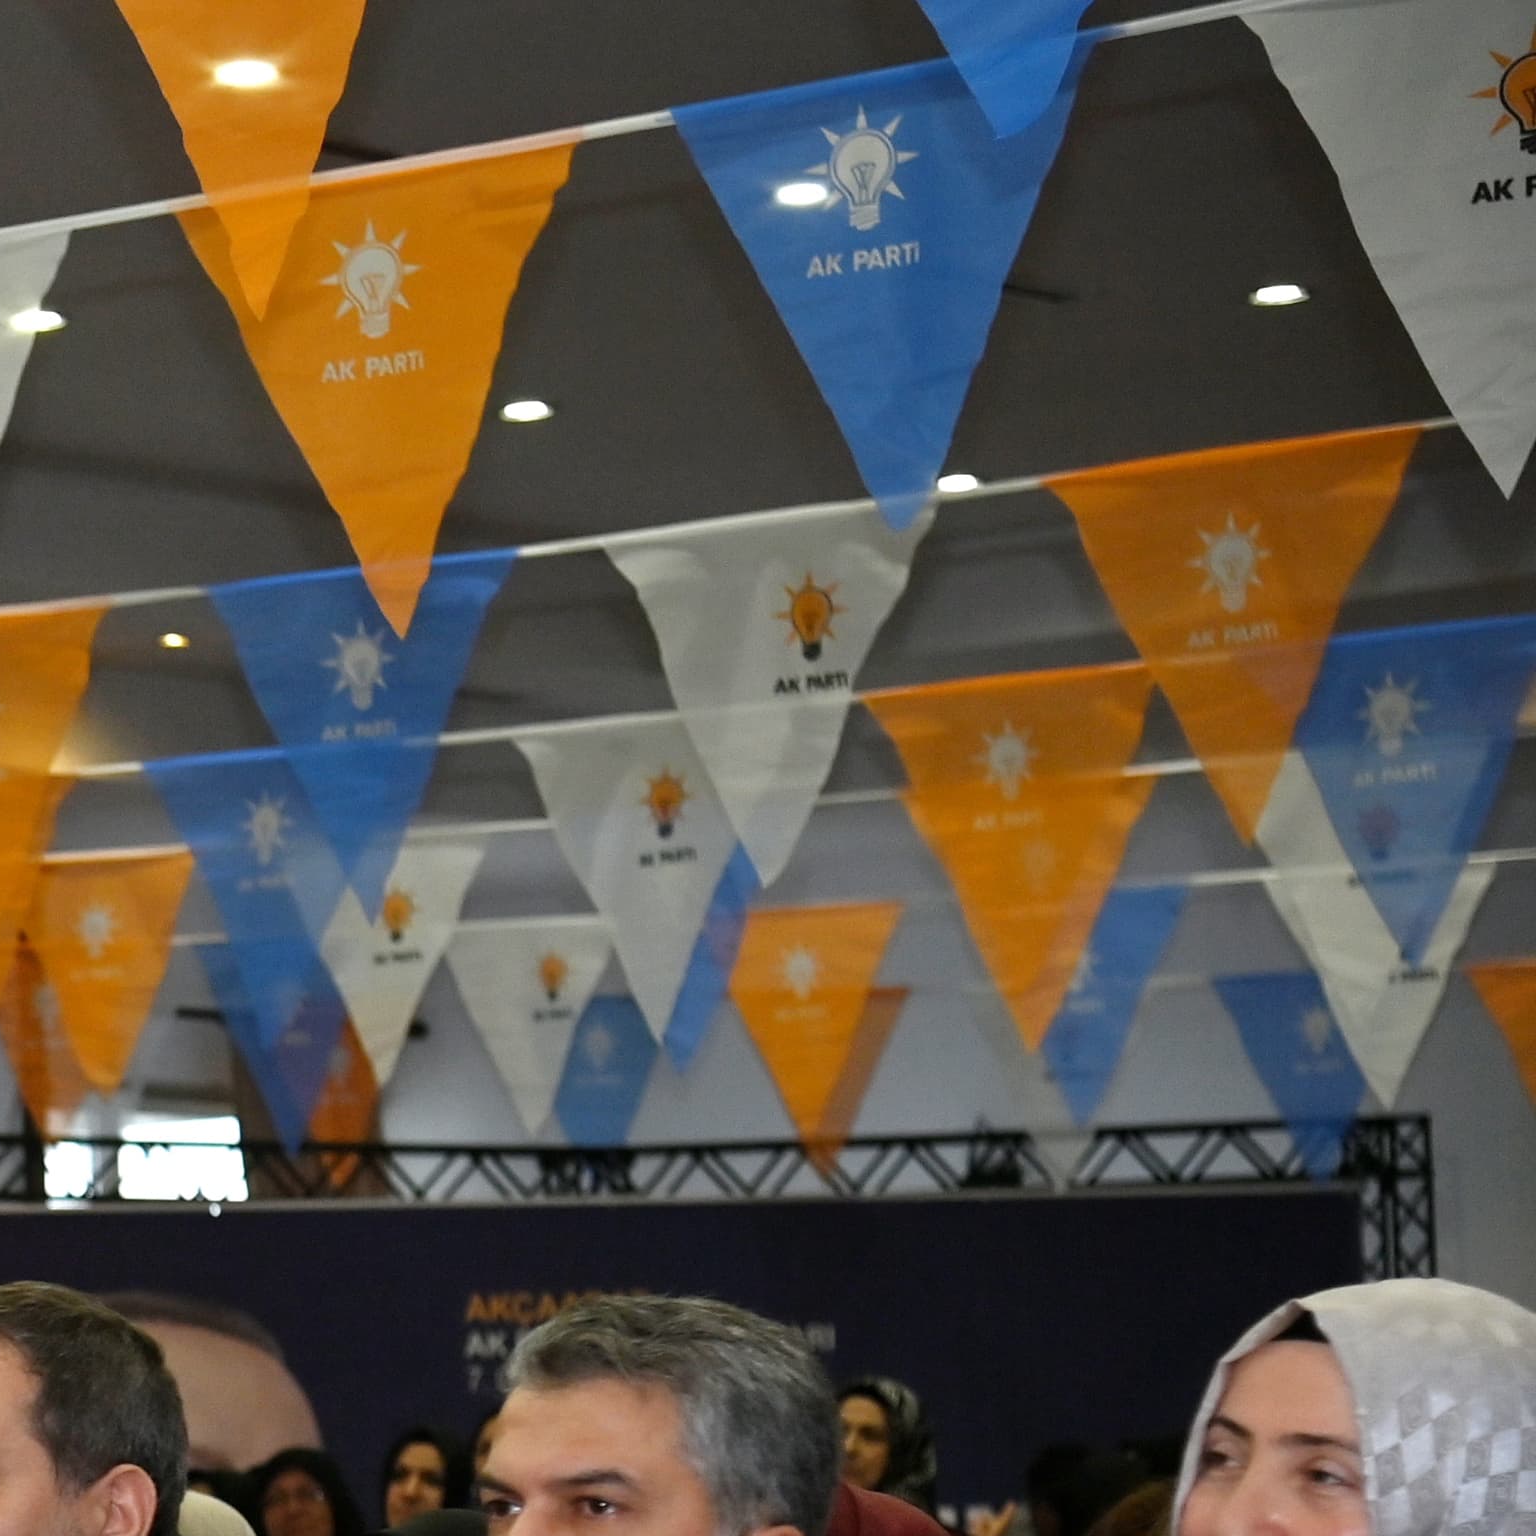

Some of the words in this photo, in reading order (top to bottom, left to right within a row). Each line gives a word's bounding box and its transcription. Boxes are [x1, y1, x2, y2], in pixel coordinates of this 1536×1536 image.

[1470, 178, 1514, 204] AK
[806, 255, 842, 278] AK
[321, 361, 356, 383] AK
[1188, 630, 1215, 648] AK
[774, 678, 803, 695] AK
